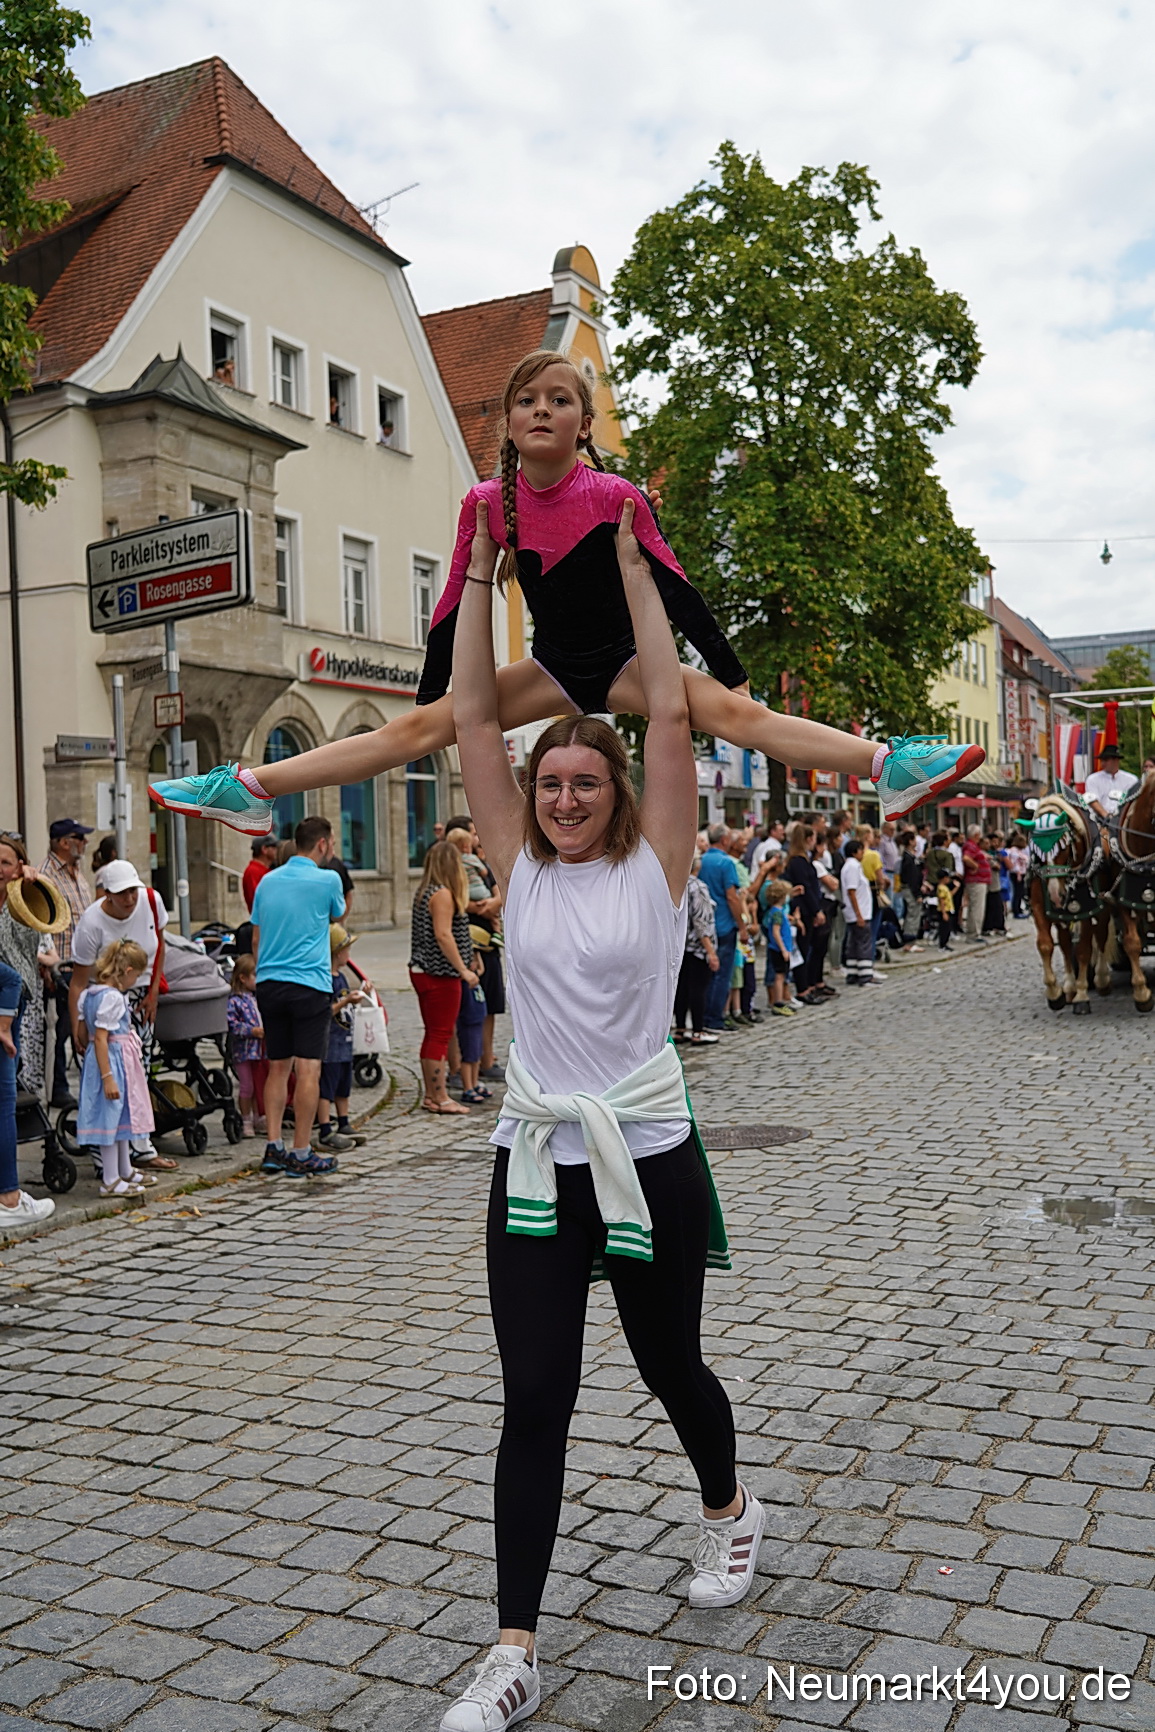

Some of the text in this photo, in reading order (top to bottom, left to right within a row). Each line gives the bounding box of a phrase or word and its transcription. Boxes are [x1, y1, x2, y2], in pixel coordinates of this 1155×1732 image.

[111, 533, 210, 571] Parkleitsystem
[146, 574, 212, 602] Rosengasse
[132, 661, 163, 682] Rosengass
